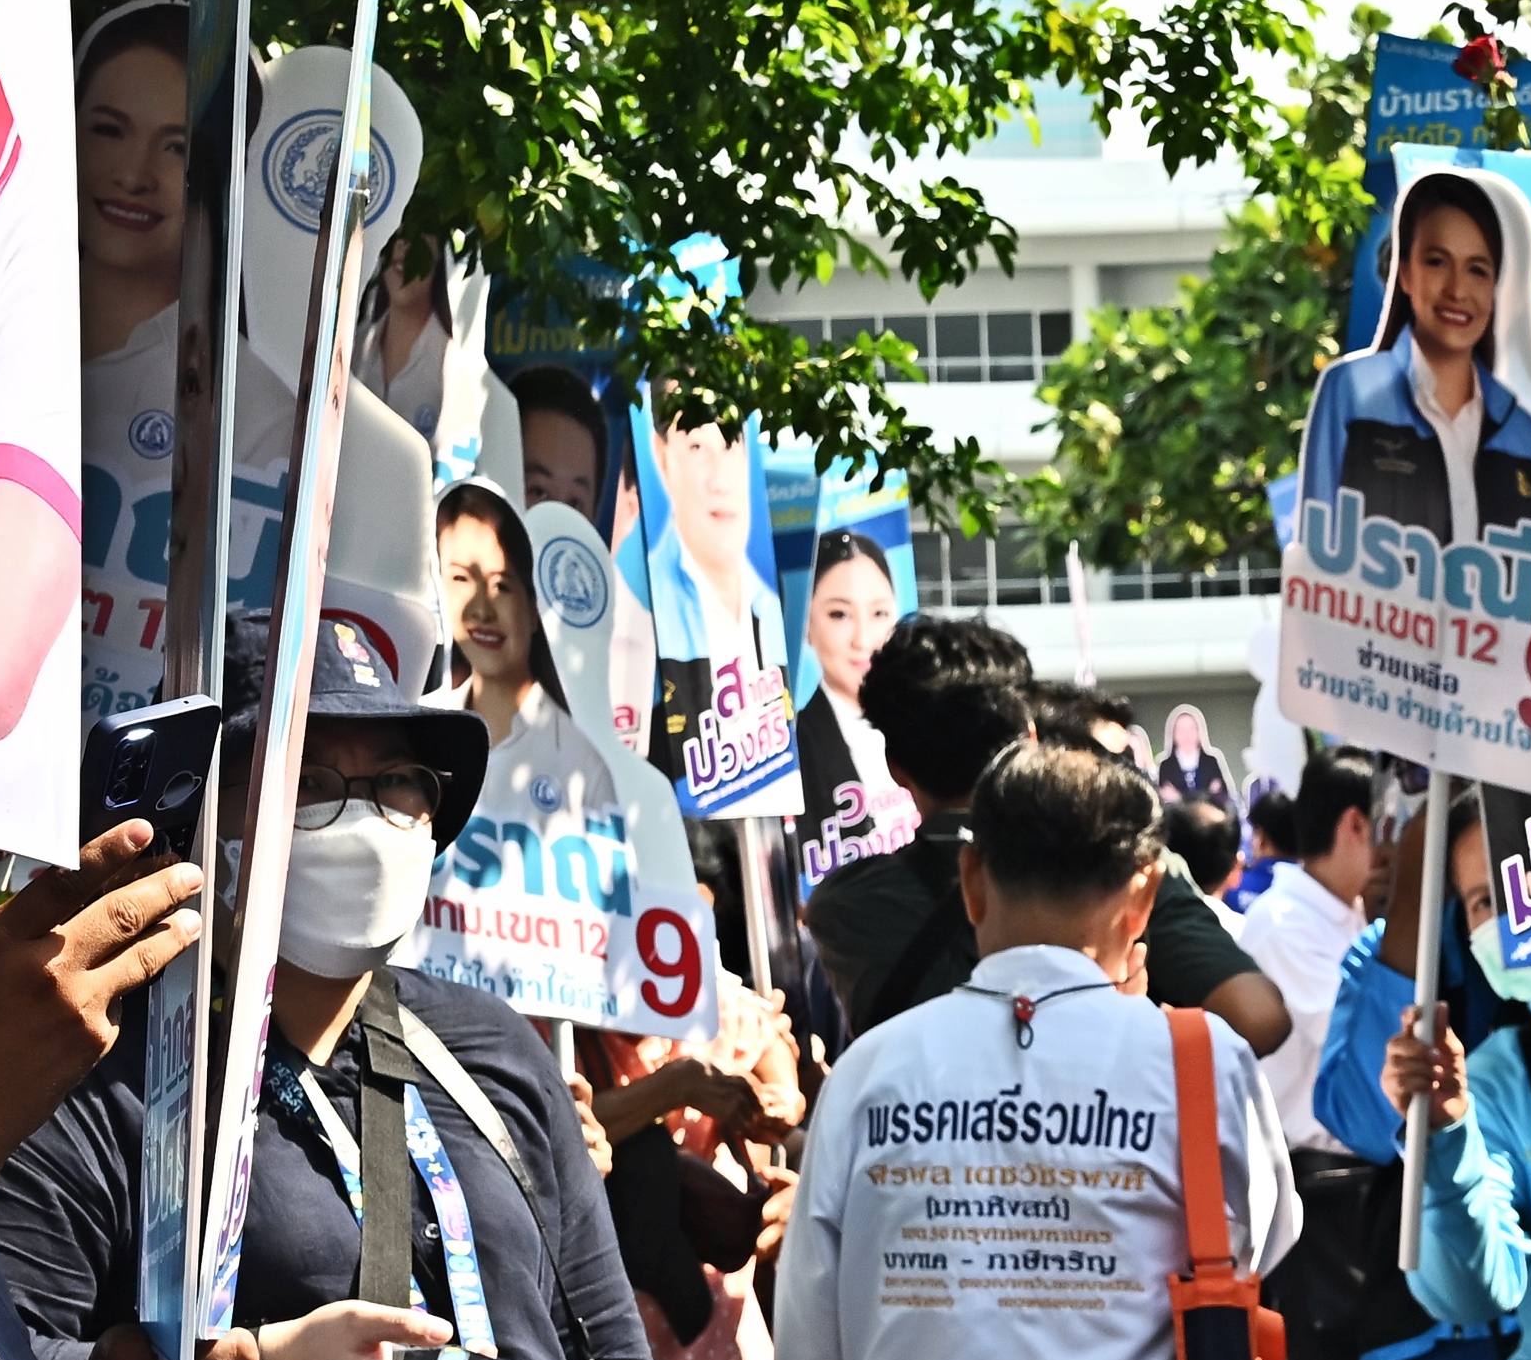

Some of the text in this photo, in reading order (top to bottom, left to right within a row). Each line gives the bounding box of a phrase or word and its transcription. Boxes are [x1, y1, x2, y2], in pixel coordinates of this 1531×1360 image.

[1286, 575, 1500, 665] กทม.เขต 12
[688, 704, 787, 789] ม่วงศิริ
[431, 812, 633, 919] ราณี
[573, 918, 608, 961] 12
[634, 907, 702, 1019] 9
[868, 1083, 1156, 1152] พรรคเสรีรวมไทย
[987, 1249, 1117, 1276] ภาษีเจริญ
